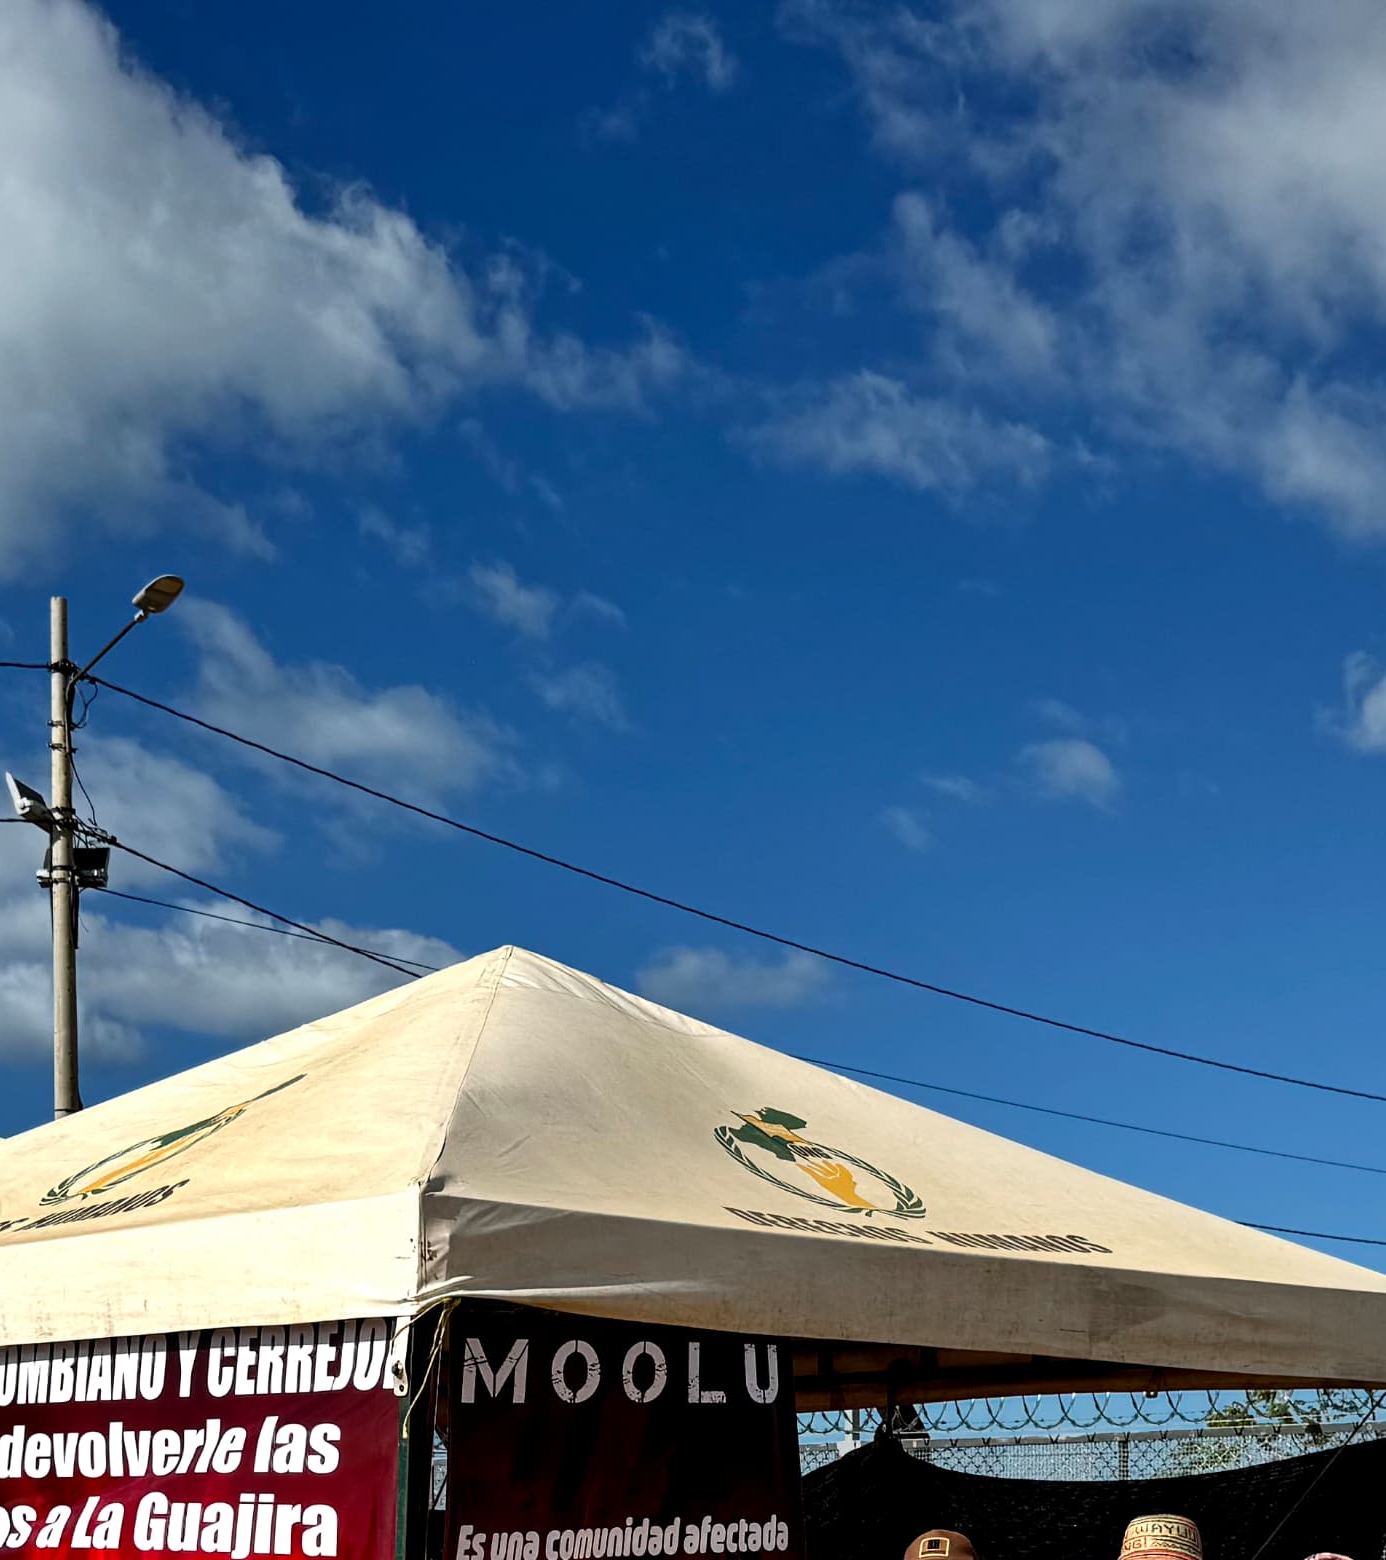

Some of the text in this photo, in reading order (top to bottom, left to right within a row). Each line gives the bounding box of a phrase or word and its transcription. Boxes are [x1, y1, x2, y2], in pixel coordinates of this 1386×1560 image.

[926, 1231, 1113, 1253] HUMANOS
[178, 1330, 202, 1398] Y
[460, 1336, 779, 1405] MOOLU
[252, 1415, 342, 1475] las
[35, 1505, 70, 1548] a
[69, 1495, 125, 1550] La
[133, 1491, 338, 1560] Guajira
[683, 1514, 789, 1555] afectada
